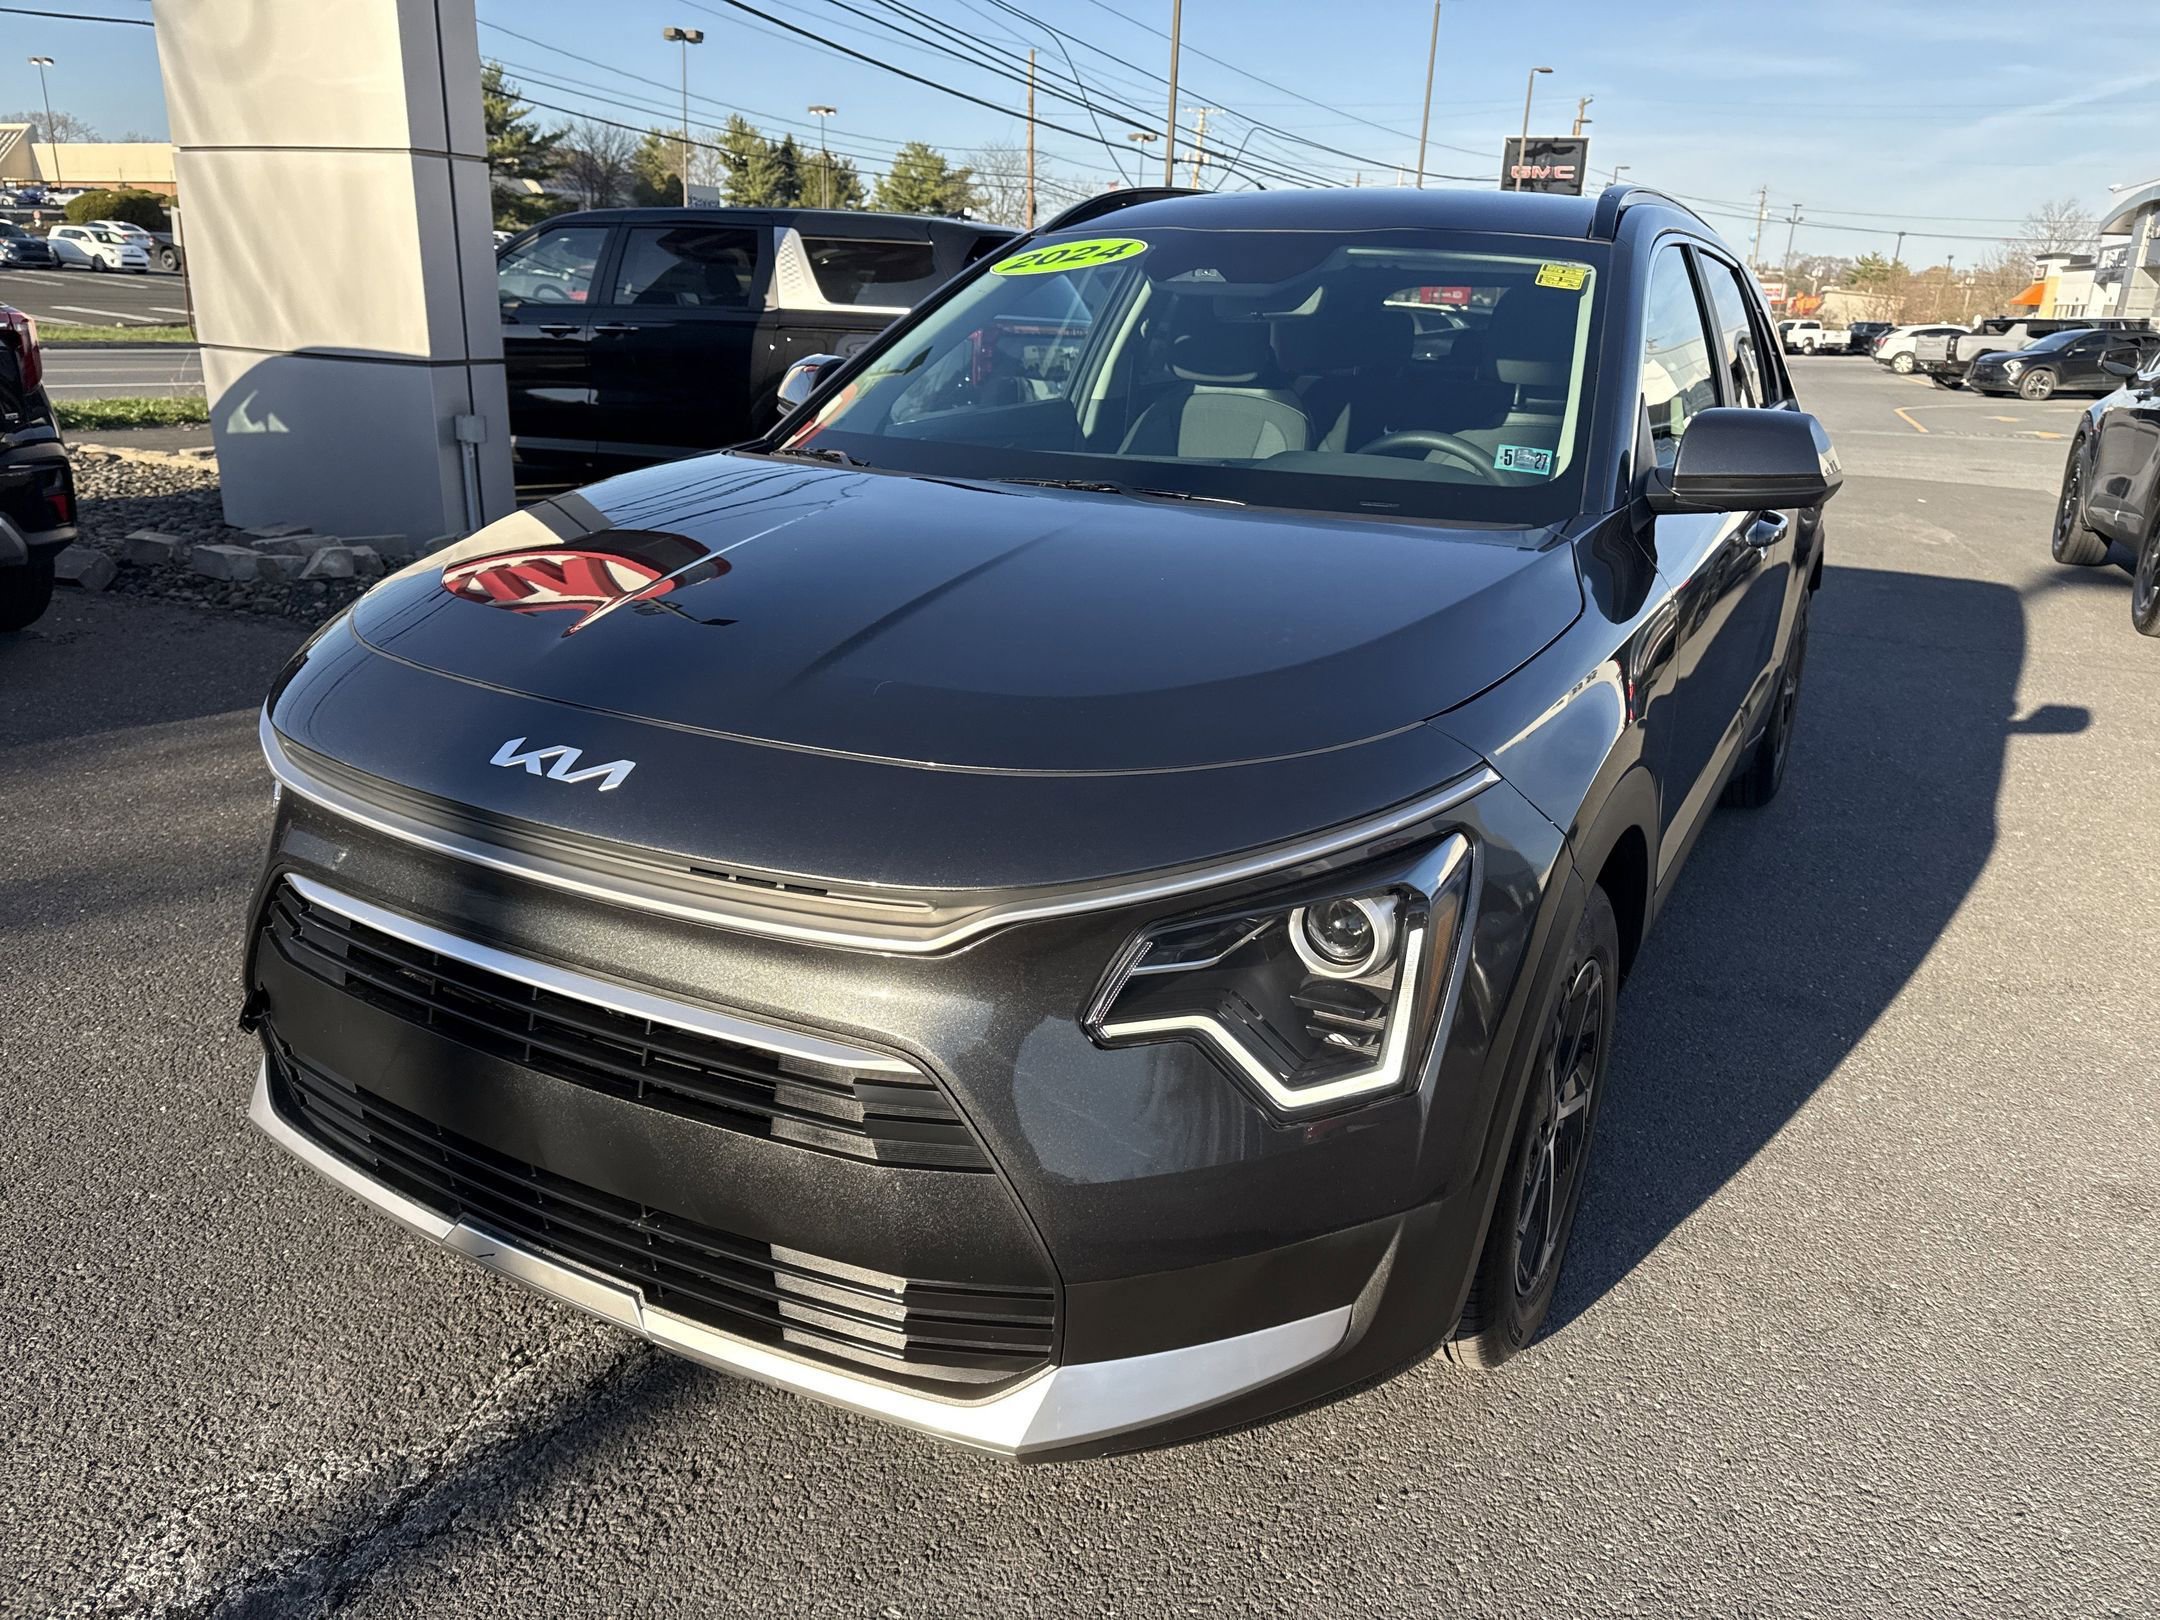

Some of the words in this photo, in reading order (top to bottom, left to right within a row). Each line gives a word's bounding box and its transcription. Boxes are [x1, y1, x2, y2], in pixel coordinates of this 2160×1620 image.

[1511, 165, 1575, 179] GMC
[1001, 242, 1135, 272] 2024
[1503, 448, 1513, 466] 5
[1534, 452, 1549, 470] 27
[489, 736, 637, 792] KIA
